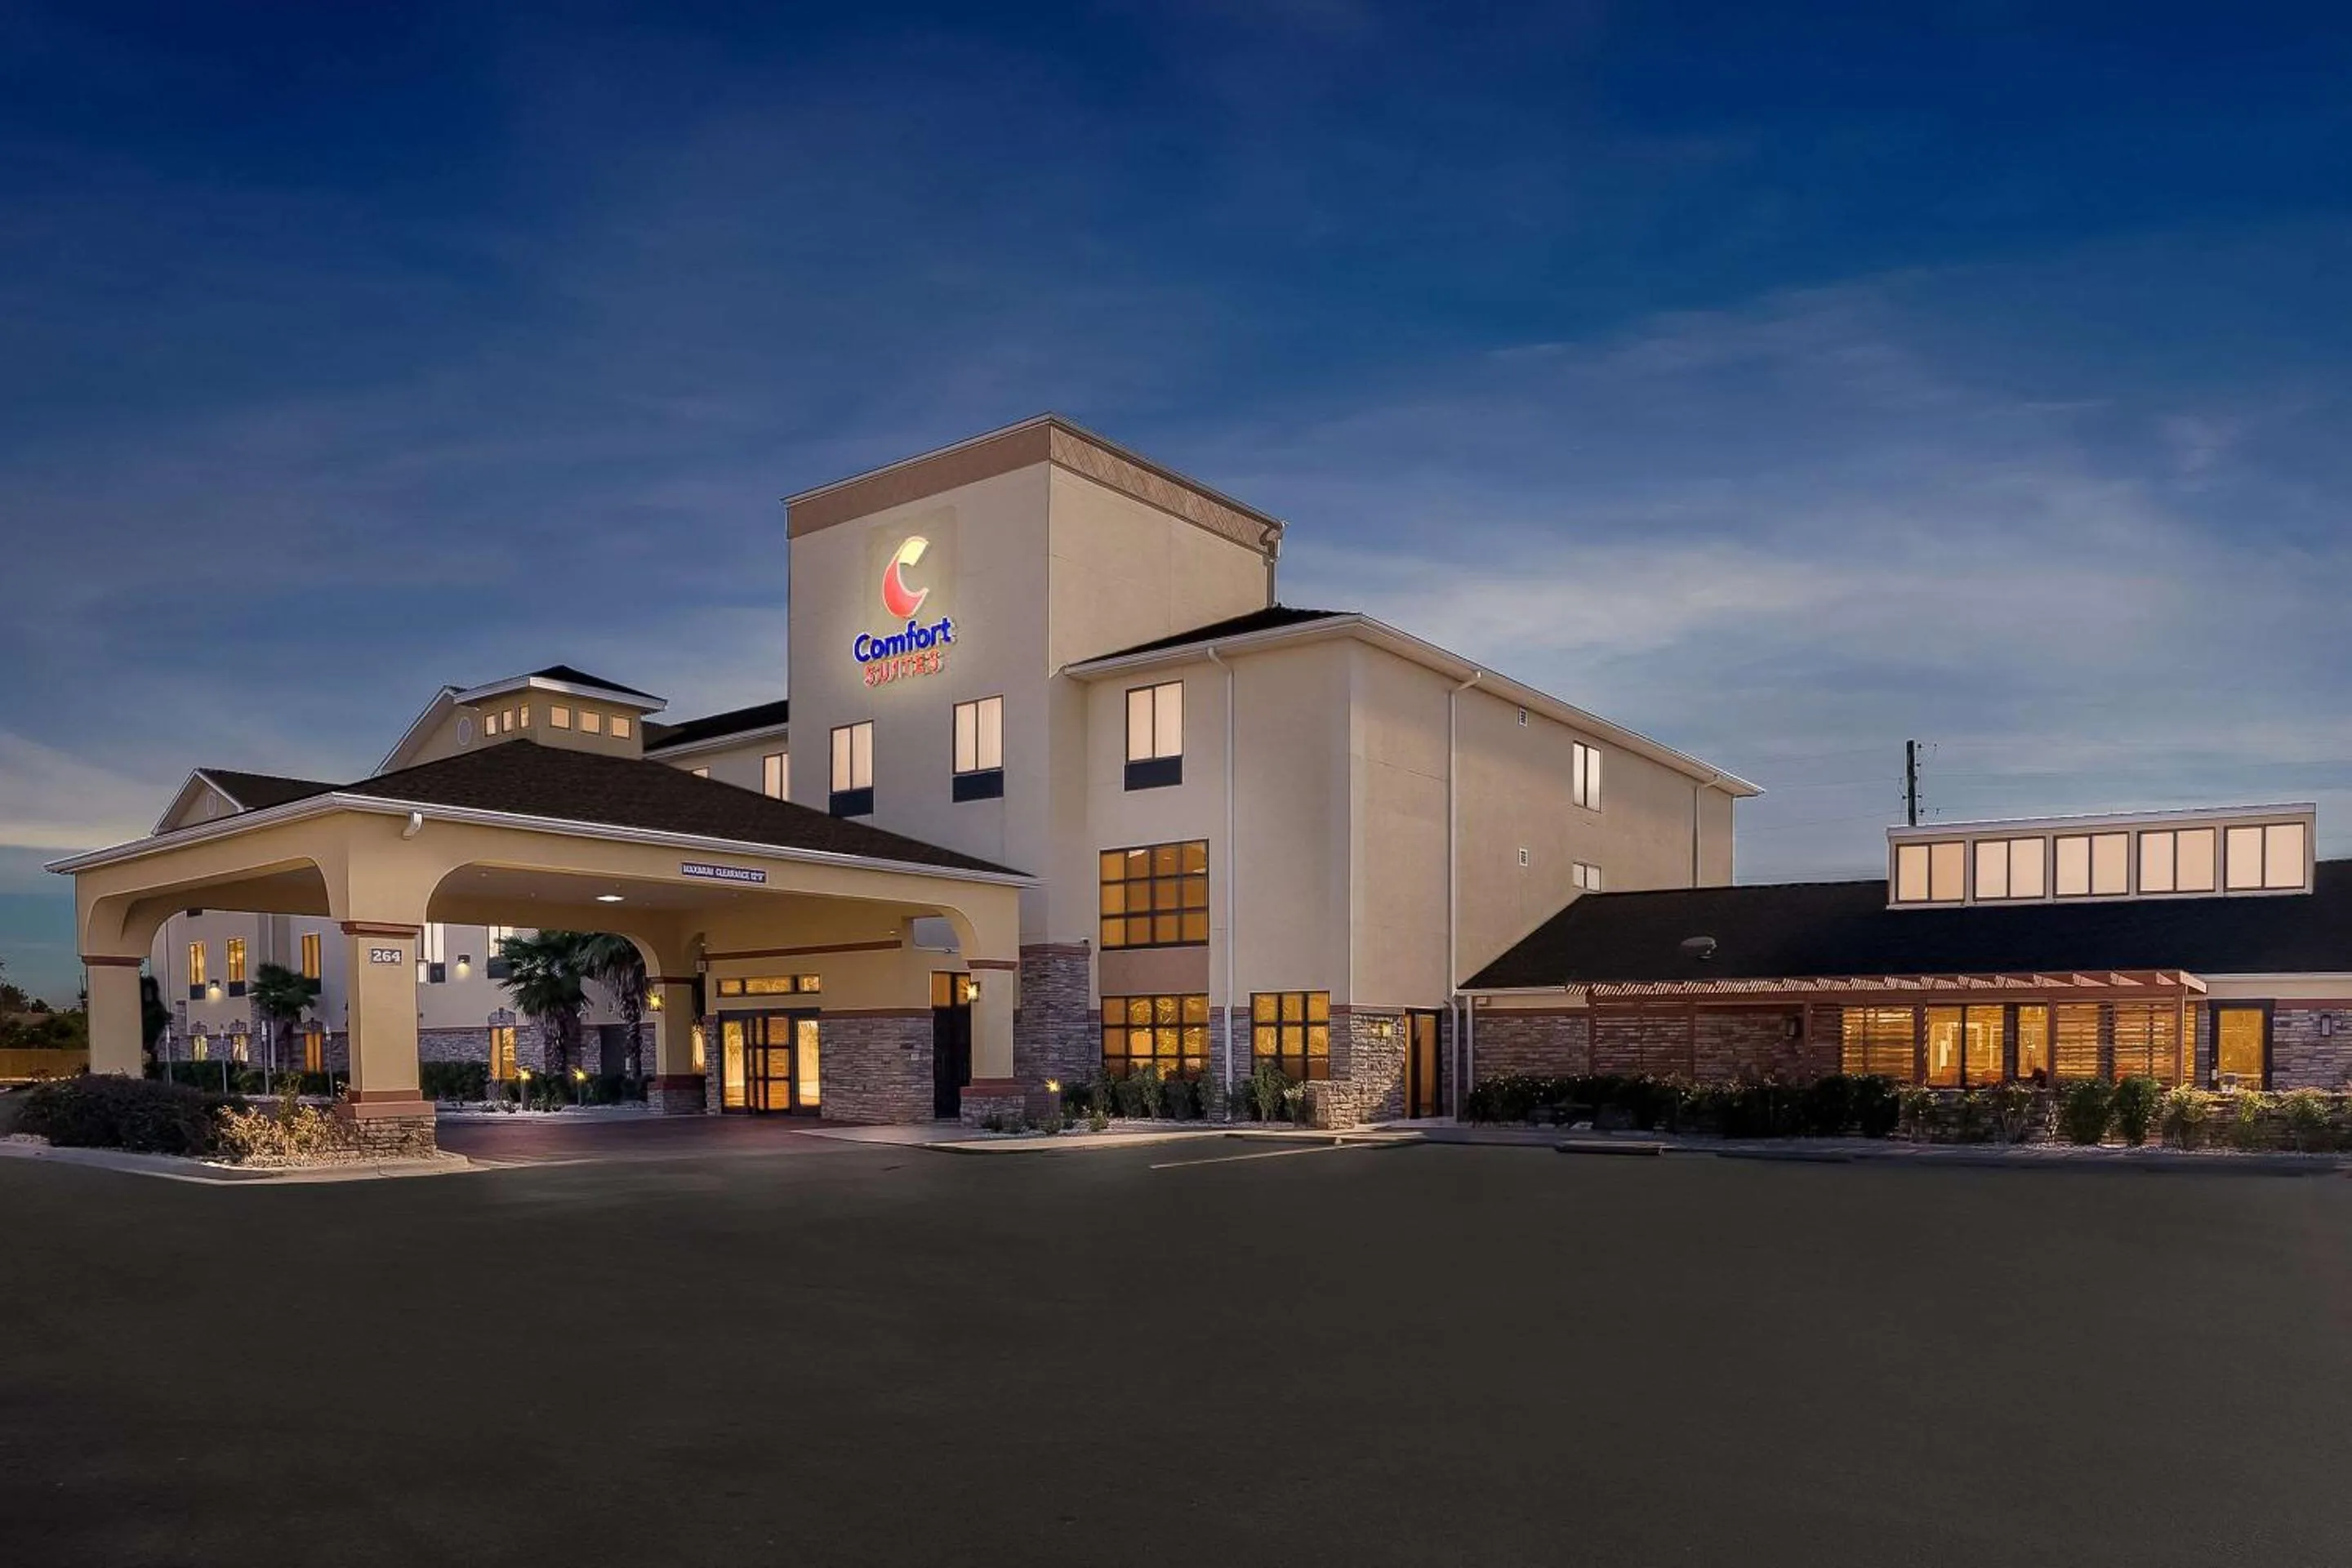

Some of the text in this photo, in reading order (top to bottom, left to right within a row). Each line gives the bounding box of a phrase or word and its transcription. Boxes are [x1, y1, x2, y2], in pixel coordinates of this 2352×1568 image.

[853, 617, 952, 662] Comfort
[864, 650, 941, 686] SUITES
[372, 950, 401, 962] 264
